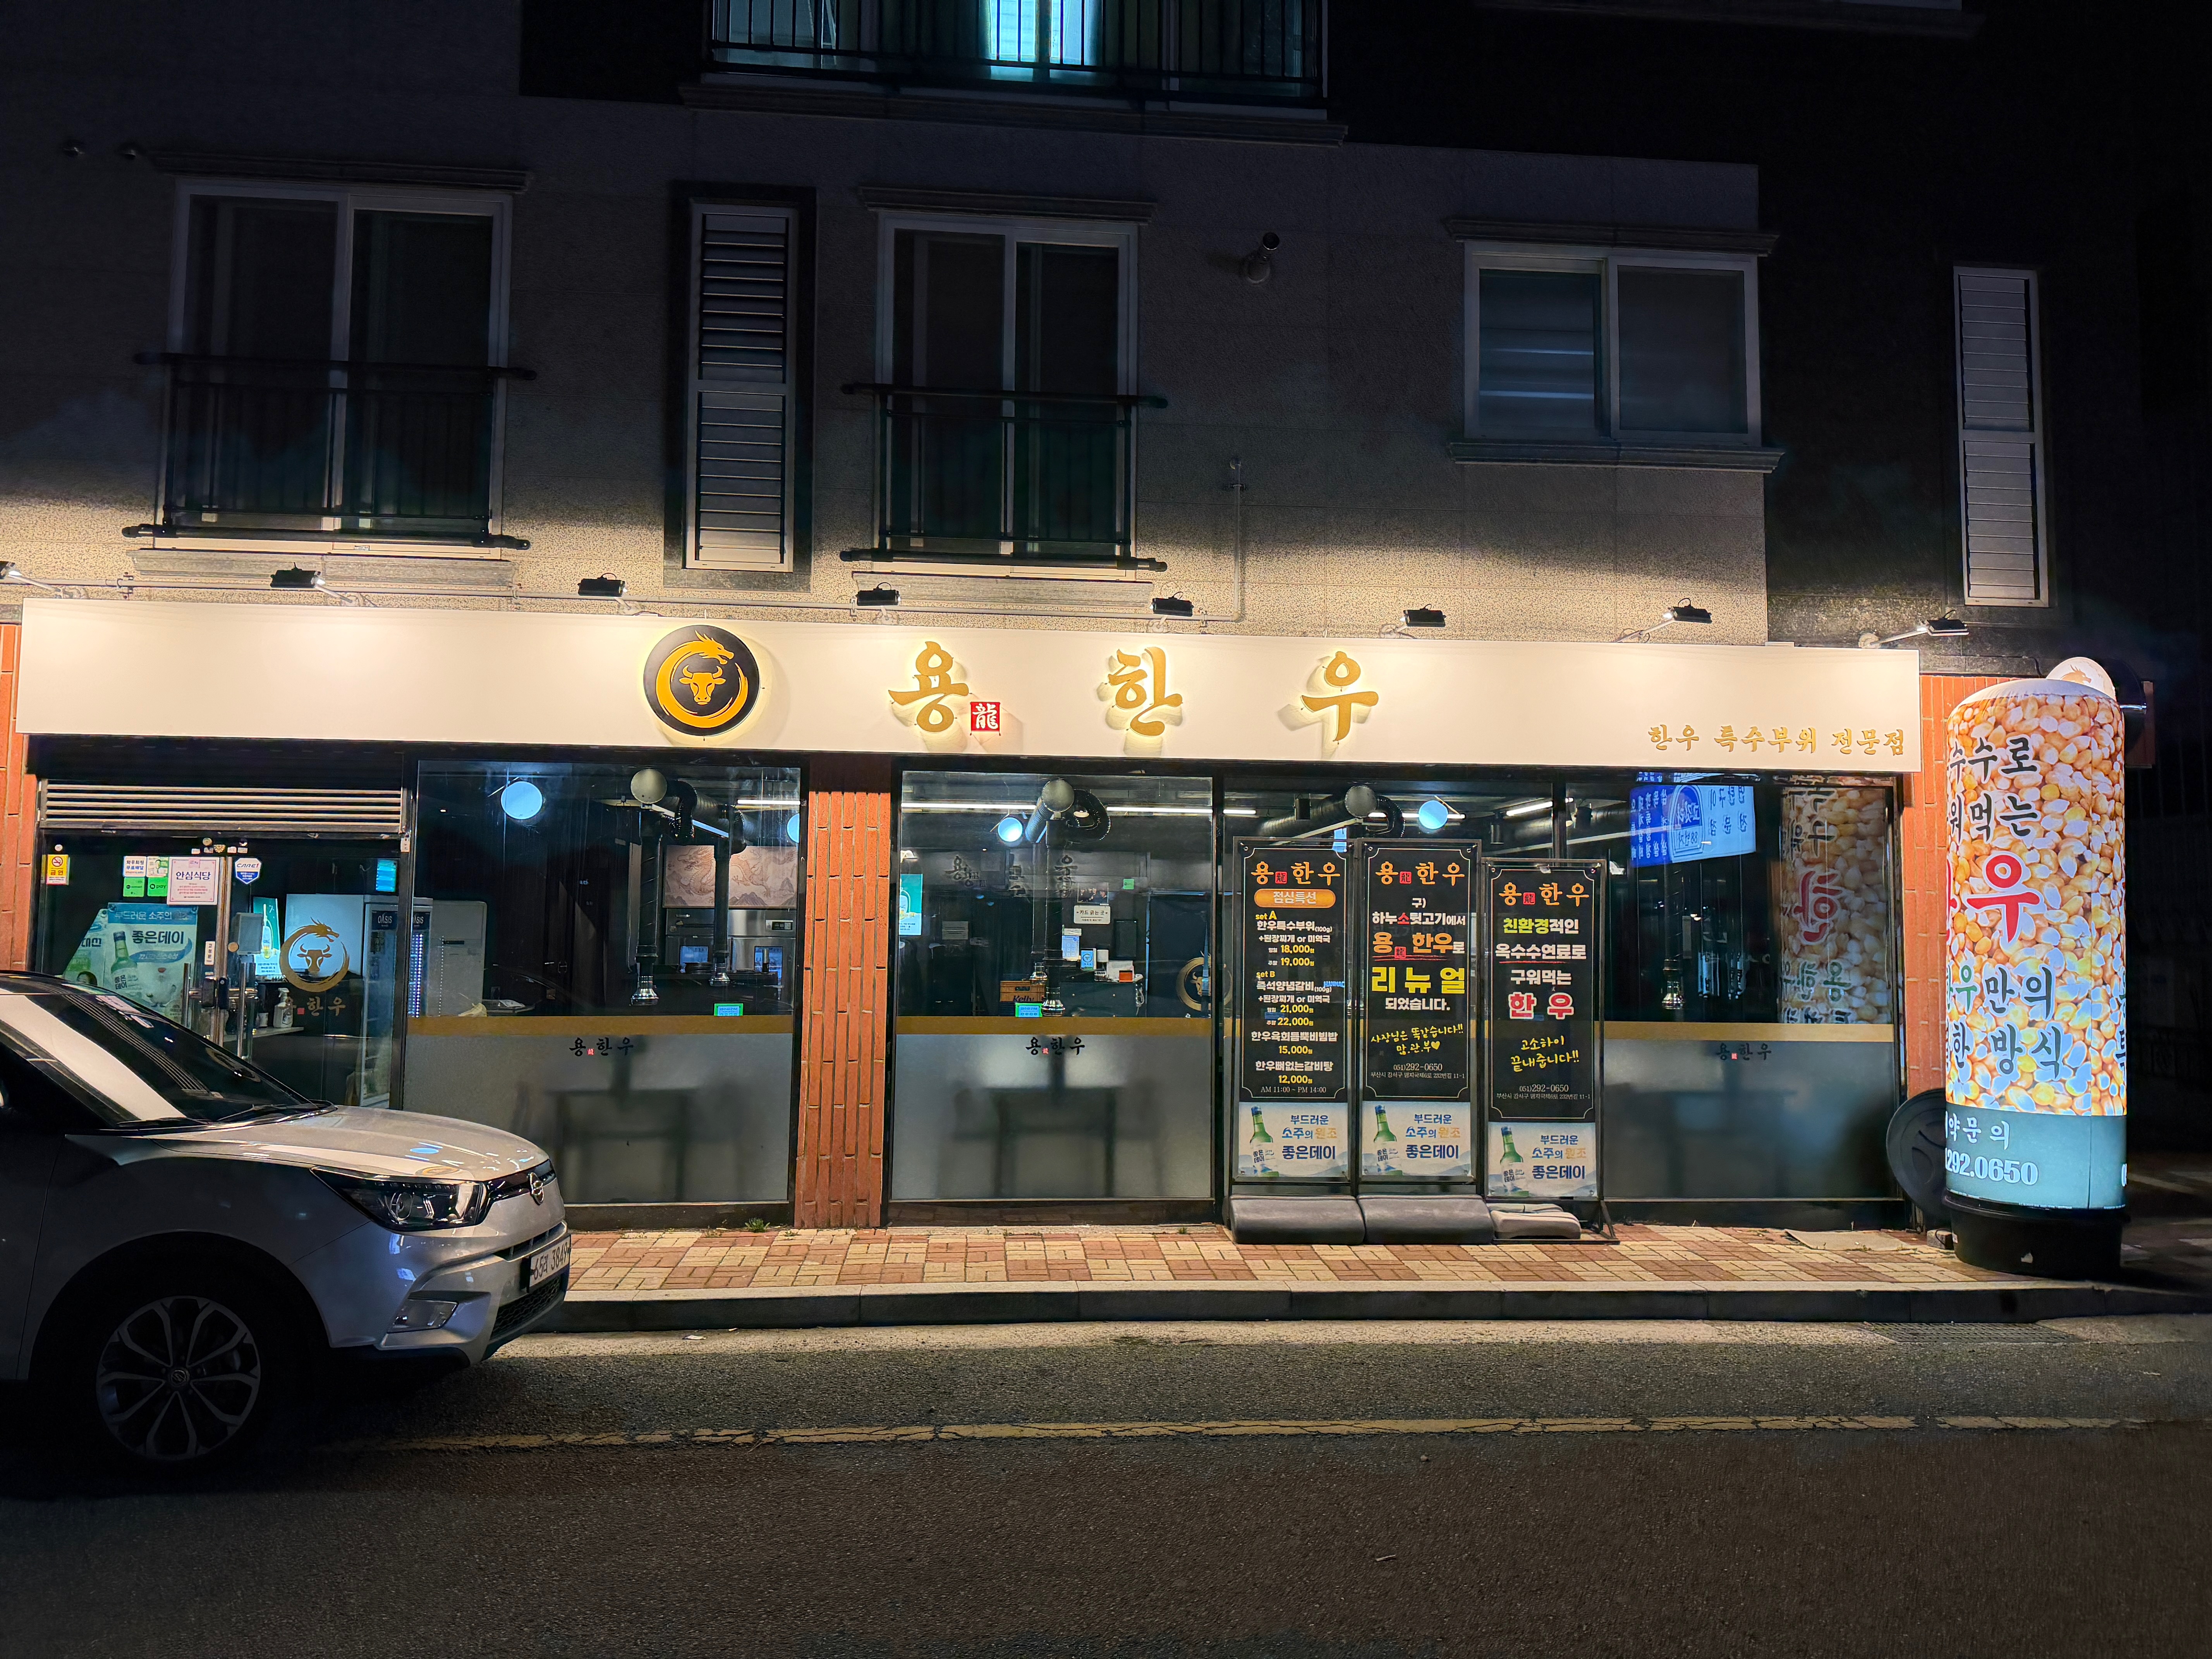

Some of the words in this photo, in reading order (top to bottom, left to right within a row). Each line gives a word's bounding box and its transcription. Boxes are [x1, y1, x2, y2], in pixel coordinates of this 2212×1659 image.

[1648, 724, 1699, 751] 한우
[1714, 725, 1816, 754] 특수부위
[1831, 728, 1903, 756] 전문점
[176, 871, 211, 880] 안심식당
[1273, 891, 1317, 904] 점심특선
[1412, 898, 1426, 908] 구)
[148, 911, 172, 920] 소주의
[378, 914, 392, 924] OASIS
[1269, 910, 1277, 920] A
[1372, 911, 1466, 926] 하누소뒷고기에서
[1503, 918, 1579, 934] 친환경적인
[132, 930, 184, 944] 좋은데이
[1308, 935, 1331, 943] 미역국
[1495, 943, 1587, 960] 옥수수연료로
[1510, 969, 1572, 986] 구워먹는
[1307, 995, 1330, 1003] 미역국
[1385, 997, 1451, 1011] 되었습니다.
[1371, 1030, 1408, 1043] 사장님은
[1411, 1023, 1464, 1040] 똑같습니다!!
[1520, 1035, 1565, 1050] 고소하이
[1255, 1060, 1334, 1072] 한우뼈없는갈비탕
[1510, 1049, 1580, 1072] 끝내줍니다!!
[1393, 1063, 1443, 1071] 051)292-0650
[1519, 1084, 1569, 1092] 051)292-0650
[1290, 1115, 1329, 1125] 부드러운
[1414, 1114, 1452, 1124] 부드러운
[1282, 1127, 1313, 1139] 소주의
[1405, 1127, 1436, 1138] 소주의
[1438, 1127, 1461, 1138] 원조
[1540, 1135, 1579, 1145] 부드러운
[1282, 1145, 1336, 1160] 좋은데이
[1405, 1144, 1459, 1159] 좋은데이
[1532, 1147, 1563, 1159] 소주의
[1532, 1165, 1585, 1179] 좋은데이
[551, 1242, 568, 1270] 3849
